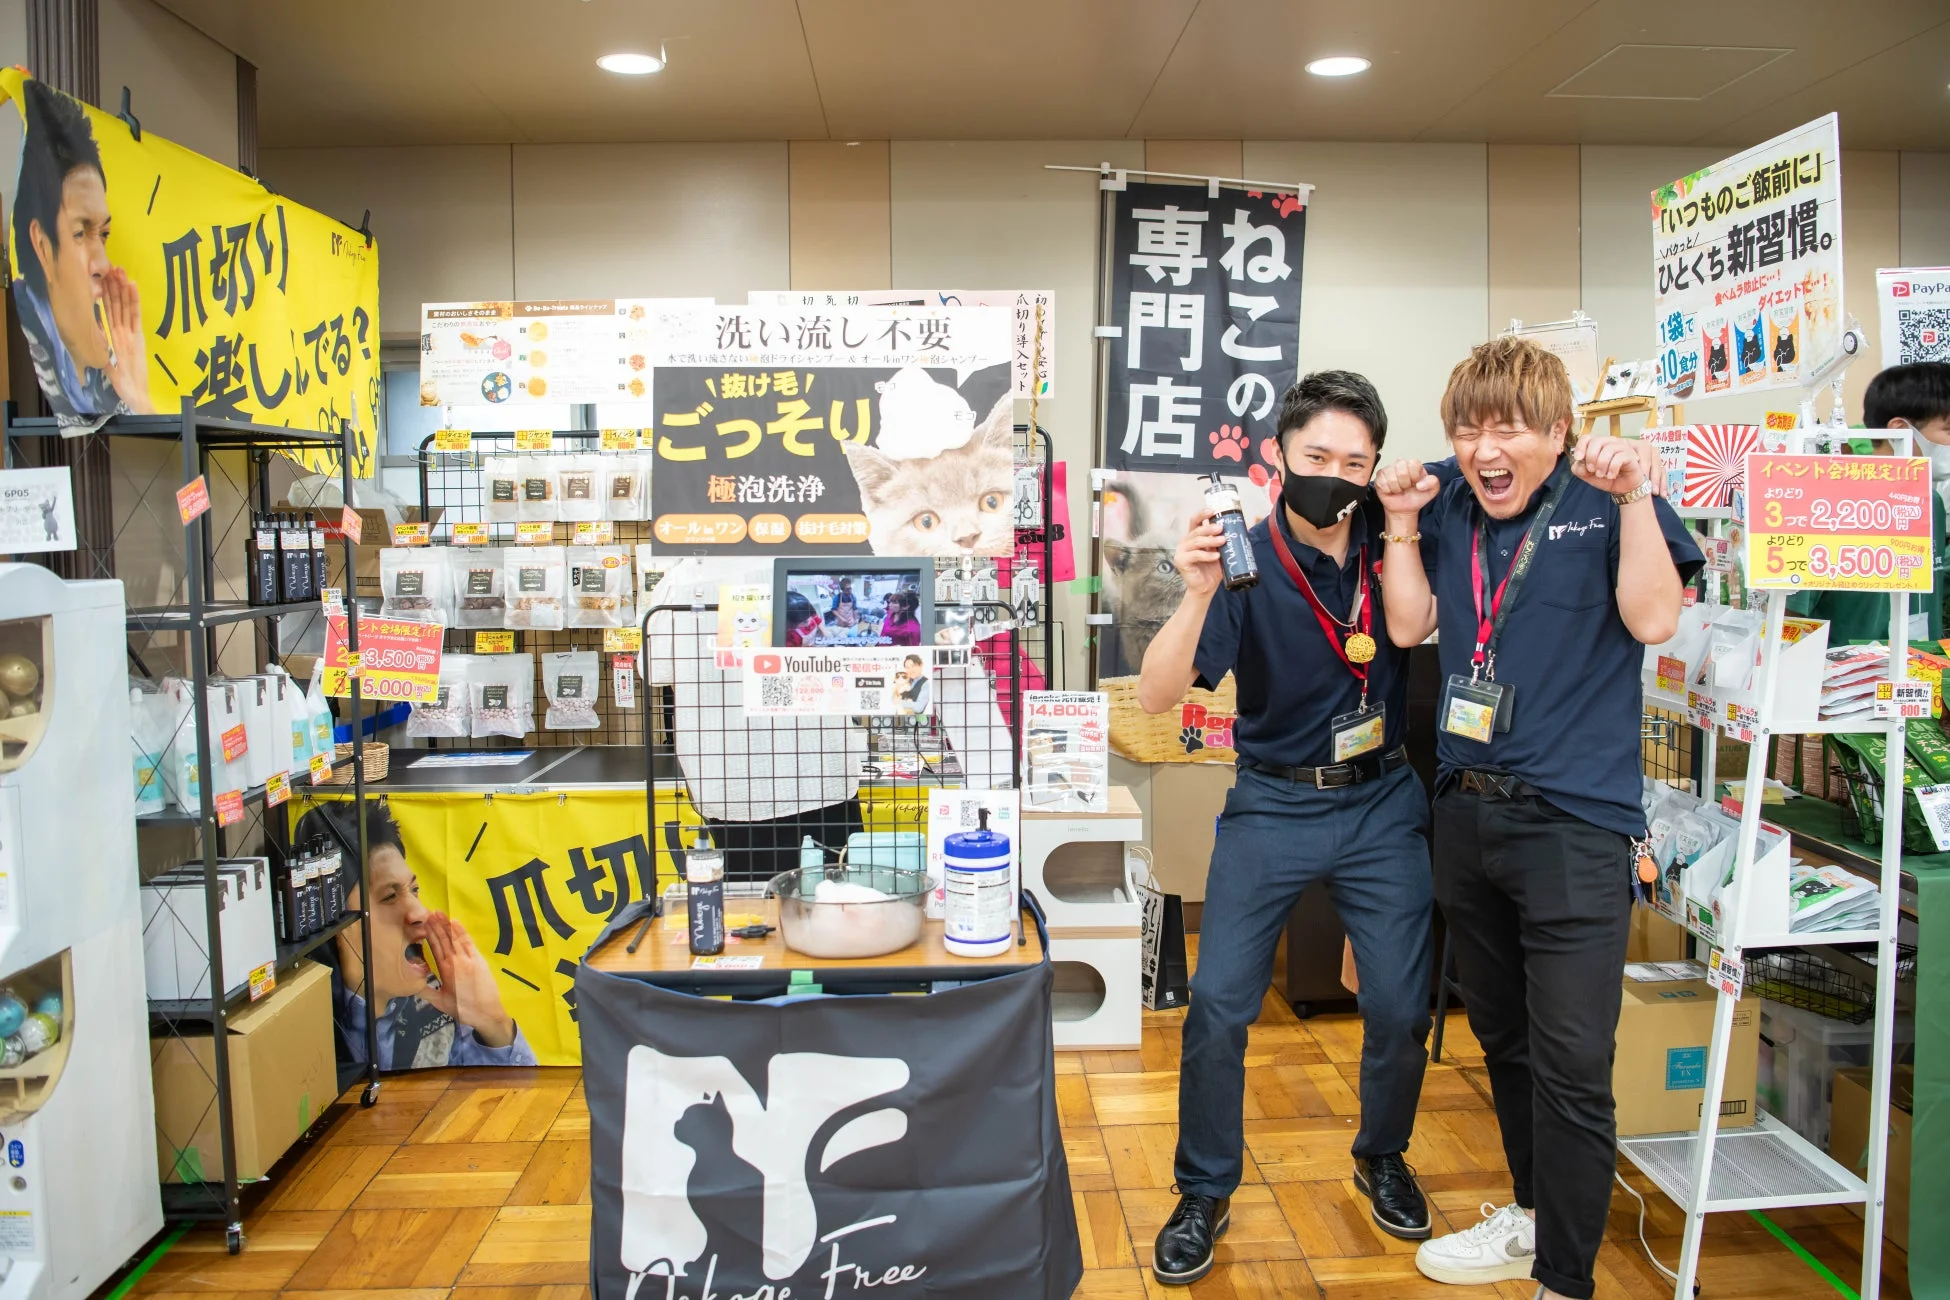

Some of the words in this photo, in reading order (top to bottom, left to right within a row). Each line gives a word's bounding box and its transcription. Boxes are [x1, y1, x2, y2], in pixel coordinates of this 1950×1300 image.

[1660, 152, 1823, 234] 「いつものご飯前に」
[1659, 199, 1833, 295] ひとくち新習慣。
[1665, 236, 1693, 257] パクっと
[156, 205, 289, 340] 爪切り
[1219, 208, 1293, 421] ねこの
[1659, 311, 1694, 344] 1袋で
[715, 313, 952, 352] 洗い流し不要
[1016, 293, 1029, 392] 爪切り導入セット
[1120, 205, 1209, 459] 専門店
[194, 305, 372, 424] 楽しんでる?
[720, 371, 800, 399] 抜け毛
[657, 397, 872, 463] ごっそり
[1660, 446, 1685, 454] ステッカー
[707, 474, 826, 504] 極泡洗浄
[1763, 487, 1804, 500] よりどり
[754, 521, 786, 537] 保湿
[797, 520, 868, 537] 抜け毛対策
[1811, 498, 1891, 531] 2,200
[1766, 535, 1804, 546] よりどり
[1808, 544, 1894, 580] 3,500
[338, 619, 442, 638] イント会場限定!!!
[365, 648, 415, 669] 3,500
[784, 655, 841, 673] YouTube
[362, 678, 413, 698] 5,000
[1028, 703, 1089, 717] 14,800
[1699, 715, 1711, 730] 800
[1900, 704, 1920, 716] 800
[1740, 728, 1753, 742] 800
[1721, 979, 1734, 996] 800
[819, 1214, 928, 1300] Free
